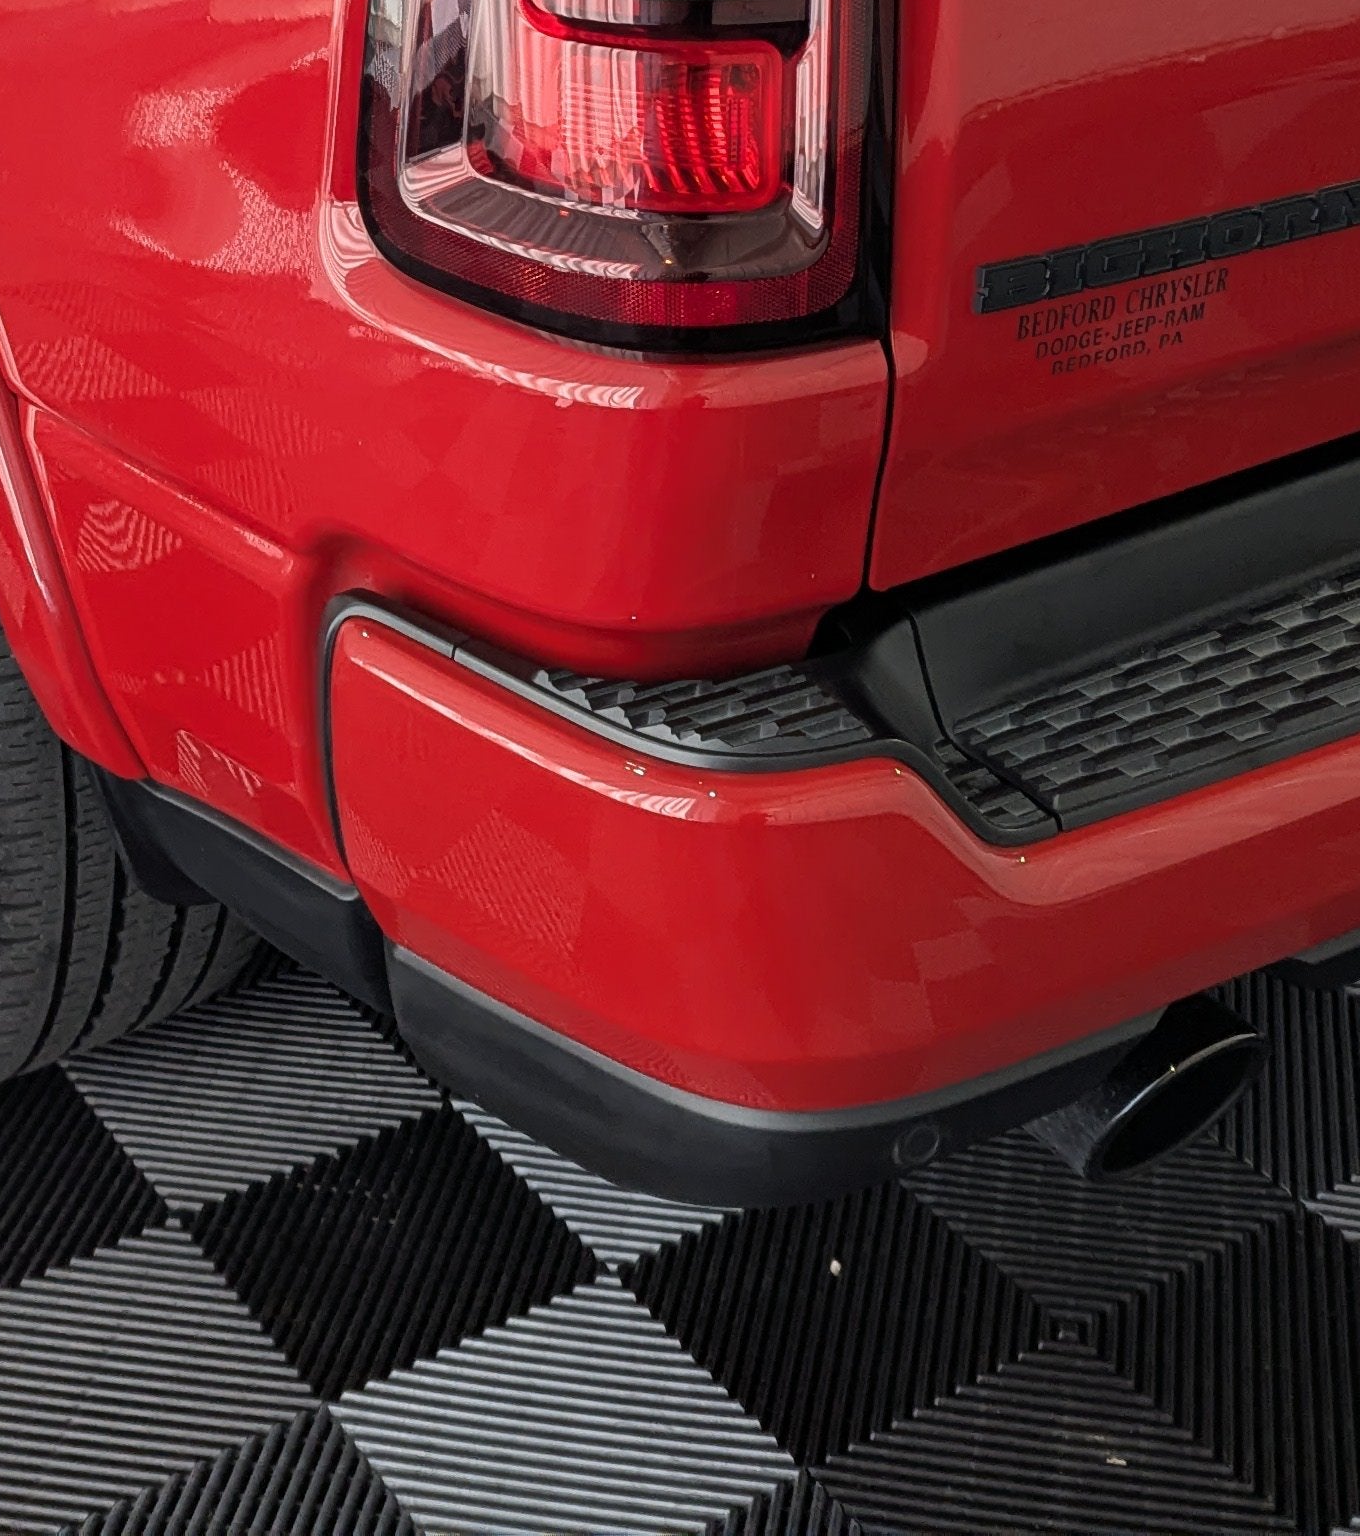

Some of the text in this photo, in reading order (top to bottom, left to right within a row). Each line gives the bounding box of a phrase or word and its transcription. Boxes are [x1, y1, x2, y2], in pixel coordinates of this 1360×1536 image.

[1016, 267, 1230, 341] BEDFORD CHRYSLER
[1051, 330, 1185, 375] BEDFORD, PA
